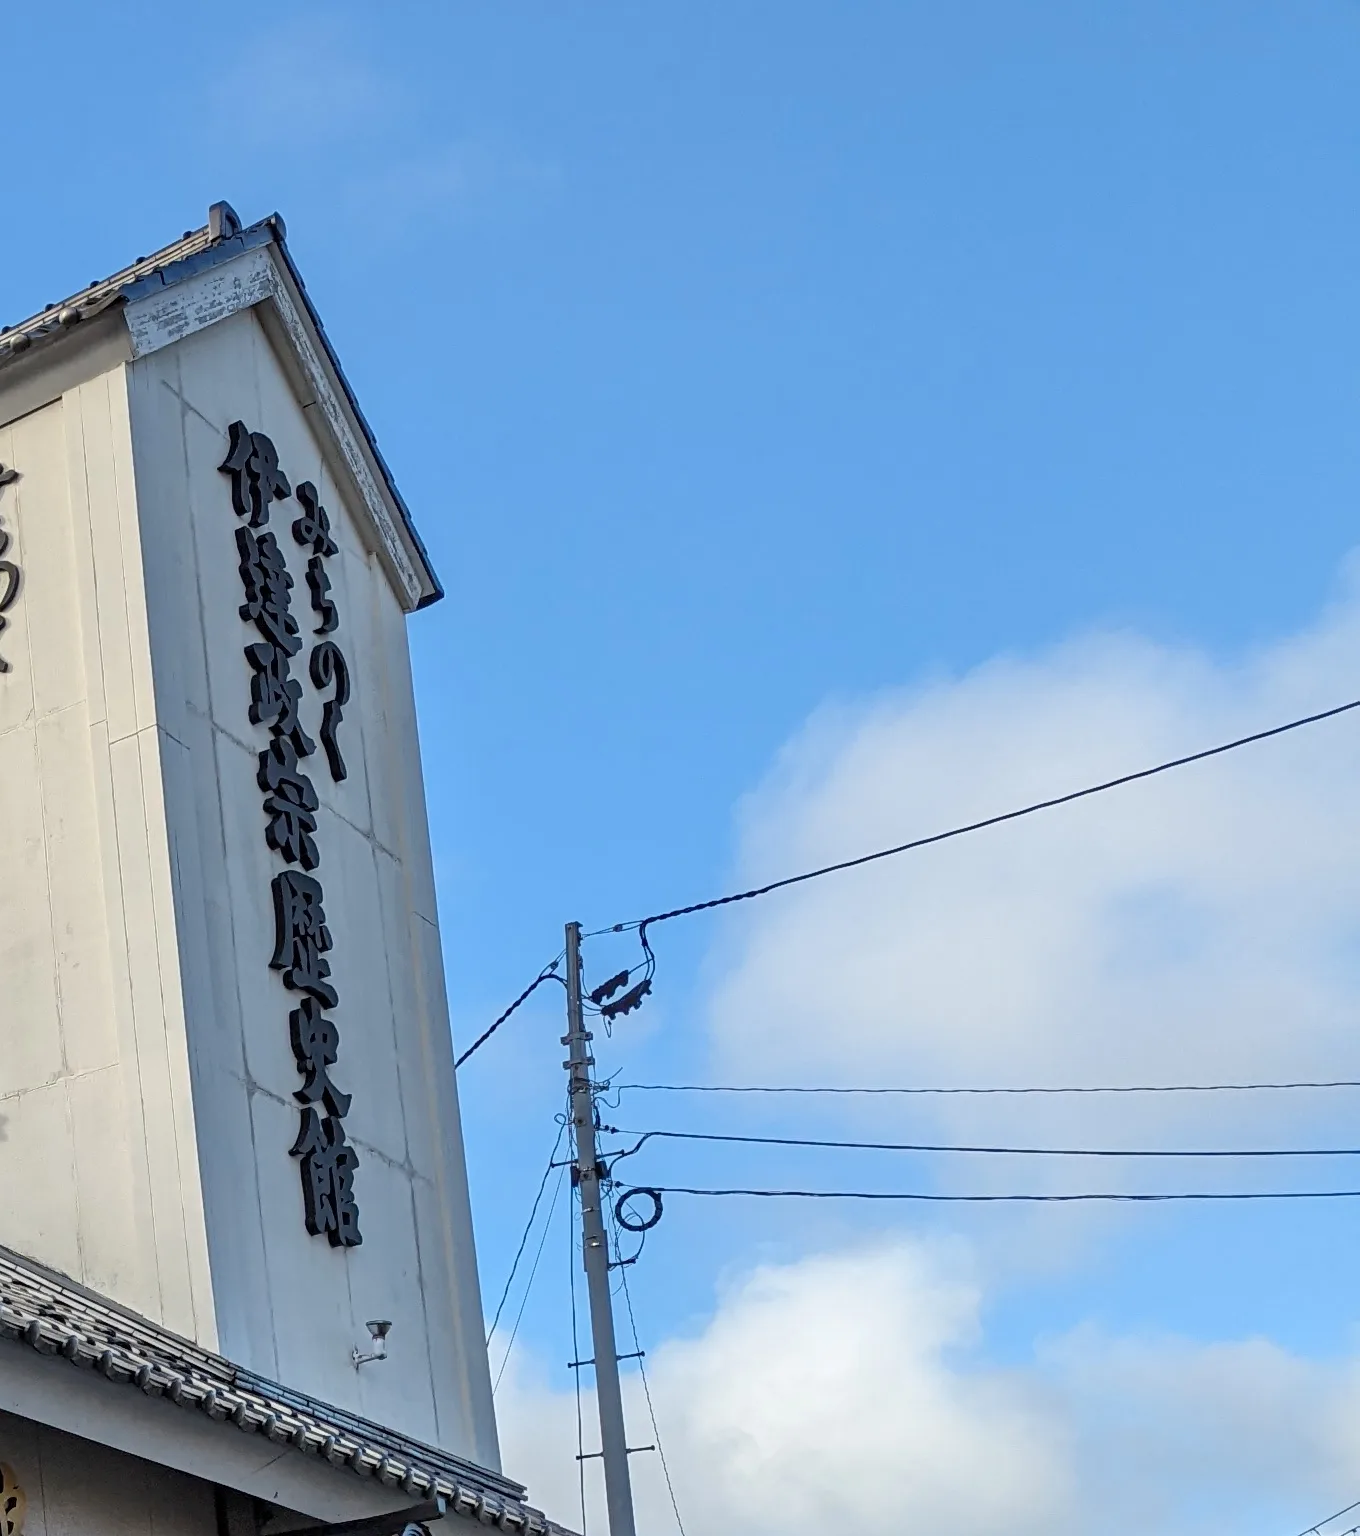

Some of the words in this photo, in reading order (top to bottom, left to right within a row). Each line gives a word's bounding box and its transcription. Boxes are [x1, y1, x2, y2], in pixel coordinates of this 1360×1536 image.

[218, 420, 363, 1247] 伊達政宗歴史館
[292, 480, 349, 782] みちのく
